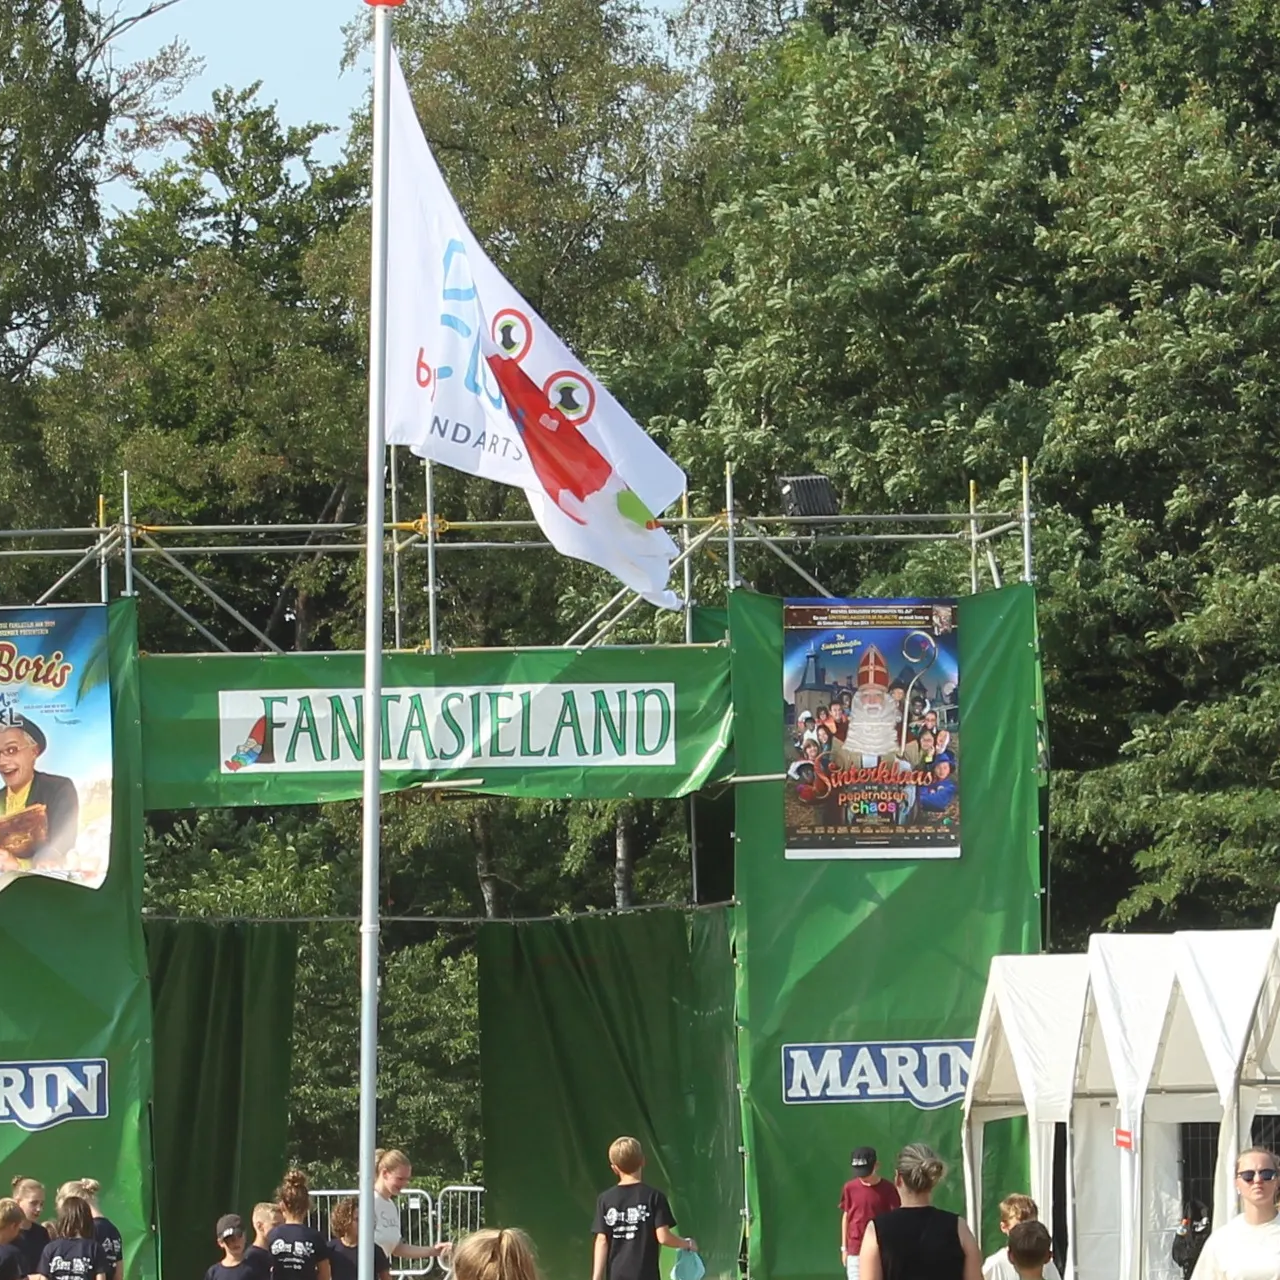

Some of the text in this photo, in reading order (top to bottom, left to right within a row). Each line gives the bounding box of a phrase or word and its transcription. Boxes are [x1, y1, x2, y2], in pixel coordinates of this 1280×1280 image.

[260, 690, 672, 764] FANTASIELAND
[812, 751, 933, 799] Sinterklaas
[838, 790, 908, 805] pepernoten
[850, 801, 897, 815] chaos
